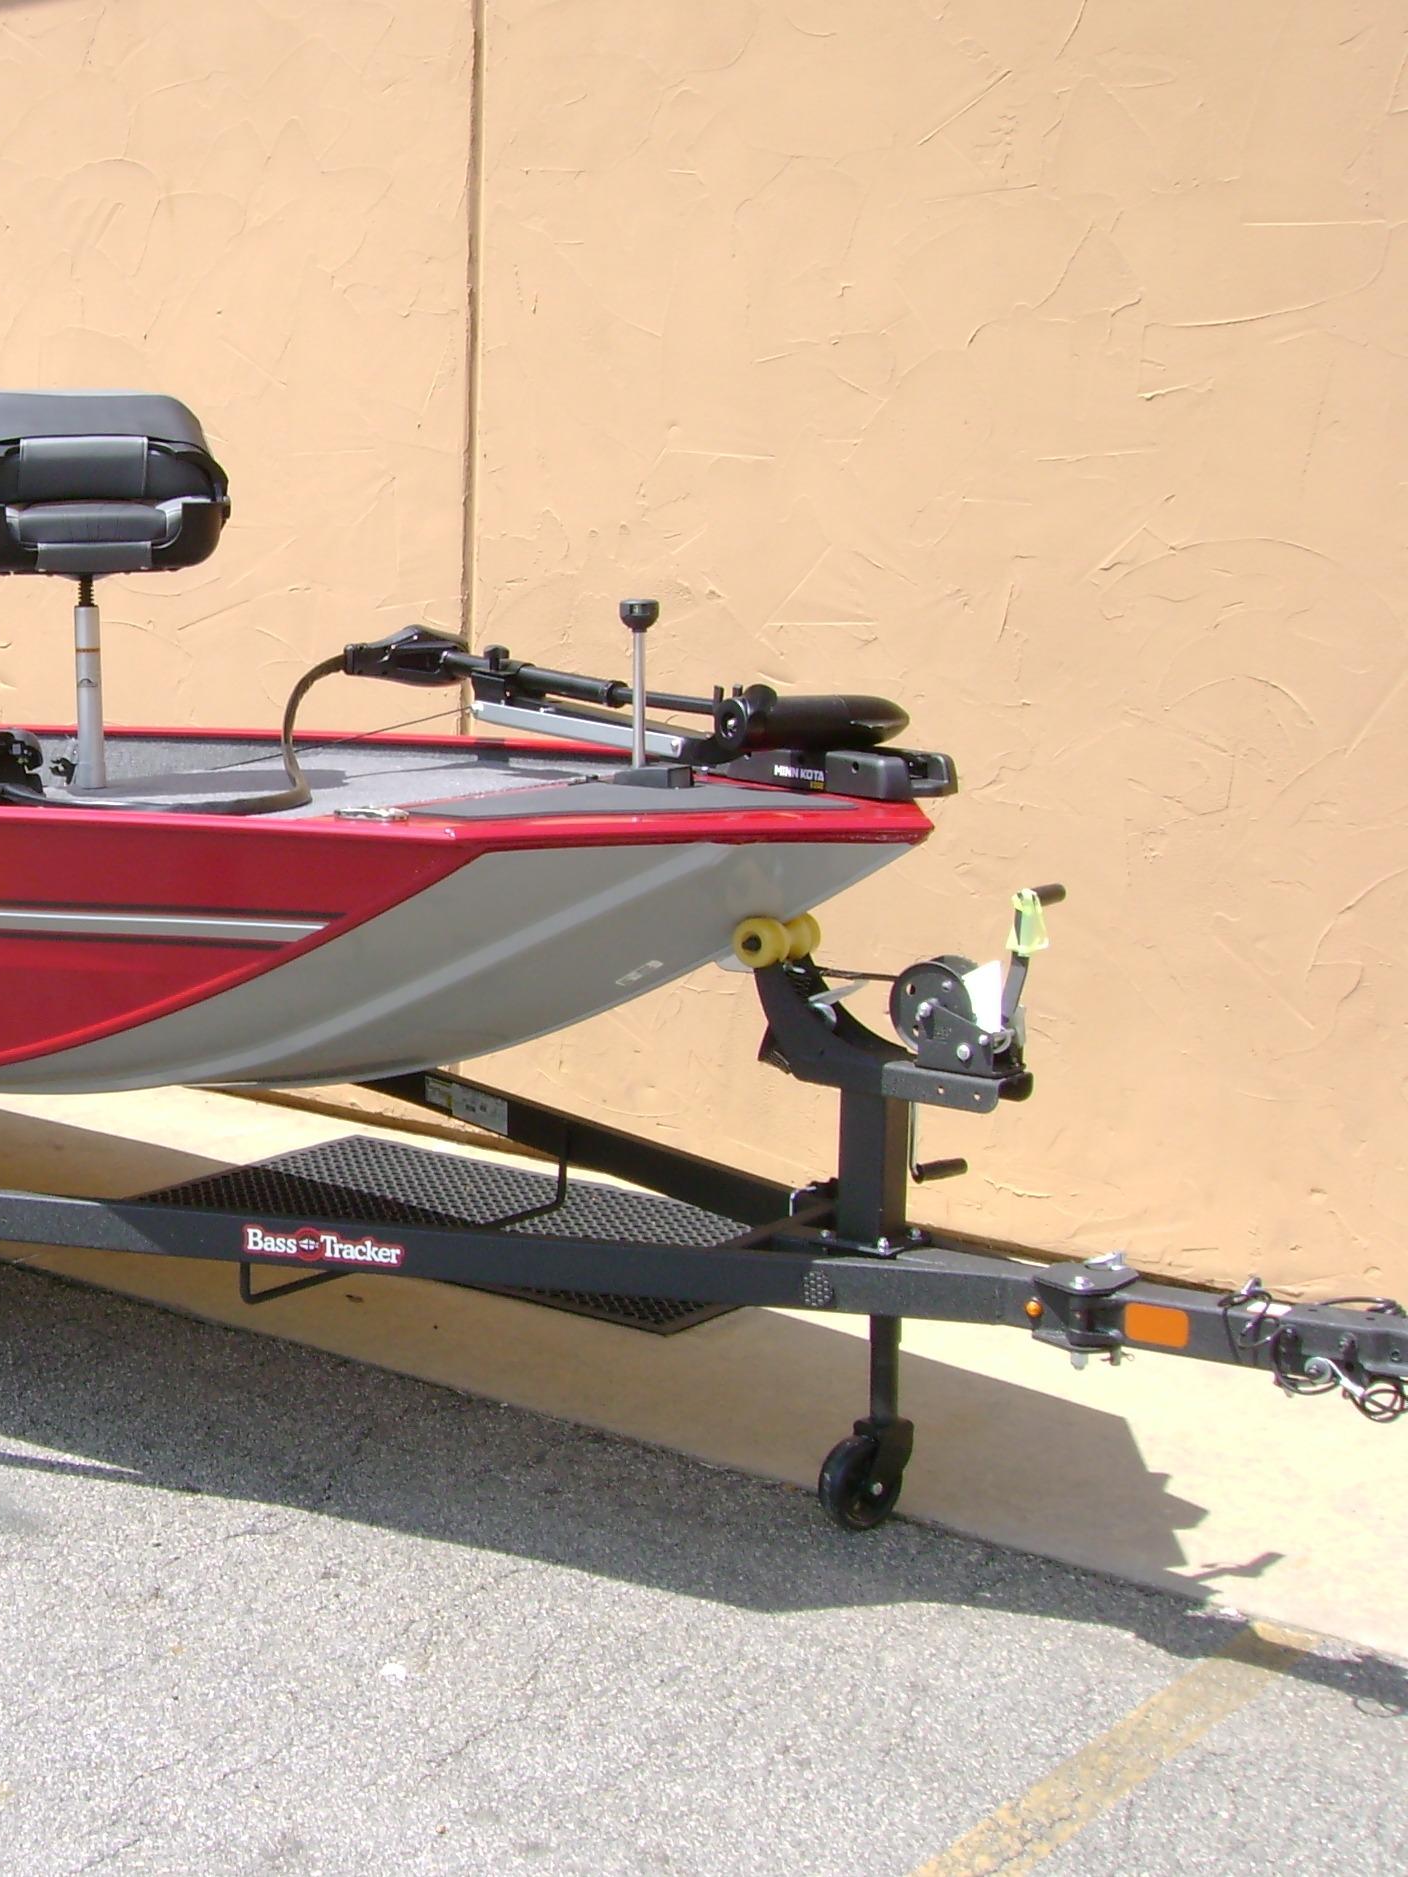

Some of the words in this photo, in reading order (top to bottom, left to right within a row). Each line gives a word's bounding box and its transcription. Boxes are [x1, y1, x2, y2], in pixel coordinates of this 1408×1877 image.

[774, 764, 799, 779] MINN
[800, 768, 825, 782] KOTA
[246, 1228, 296, 1253] Bass
[320, 1235, 400, 1264] Tracker
